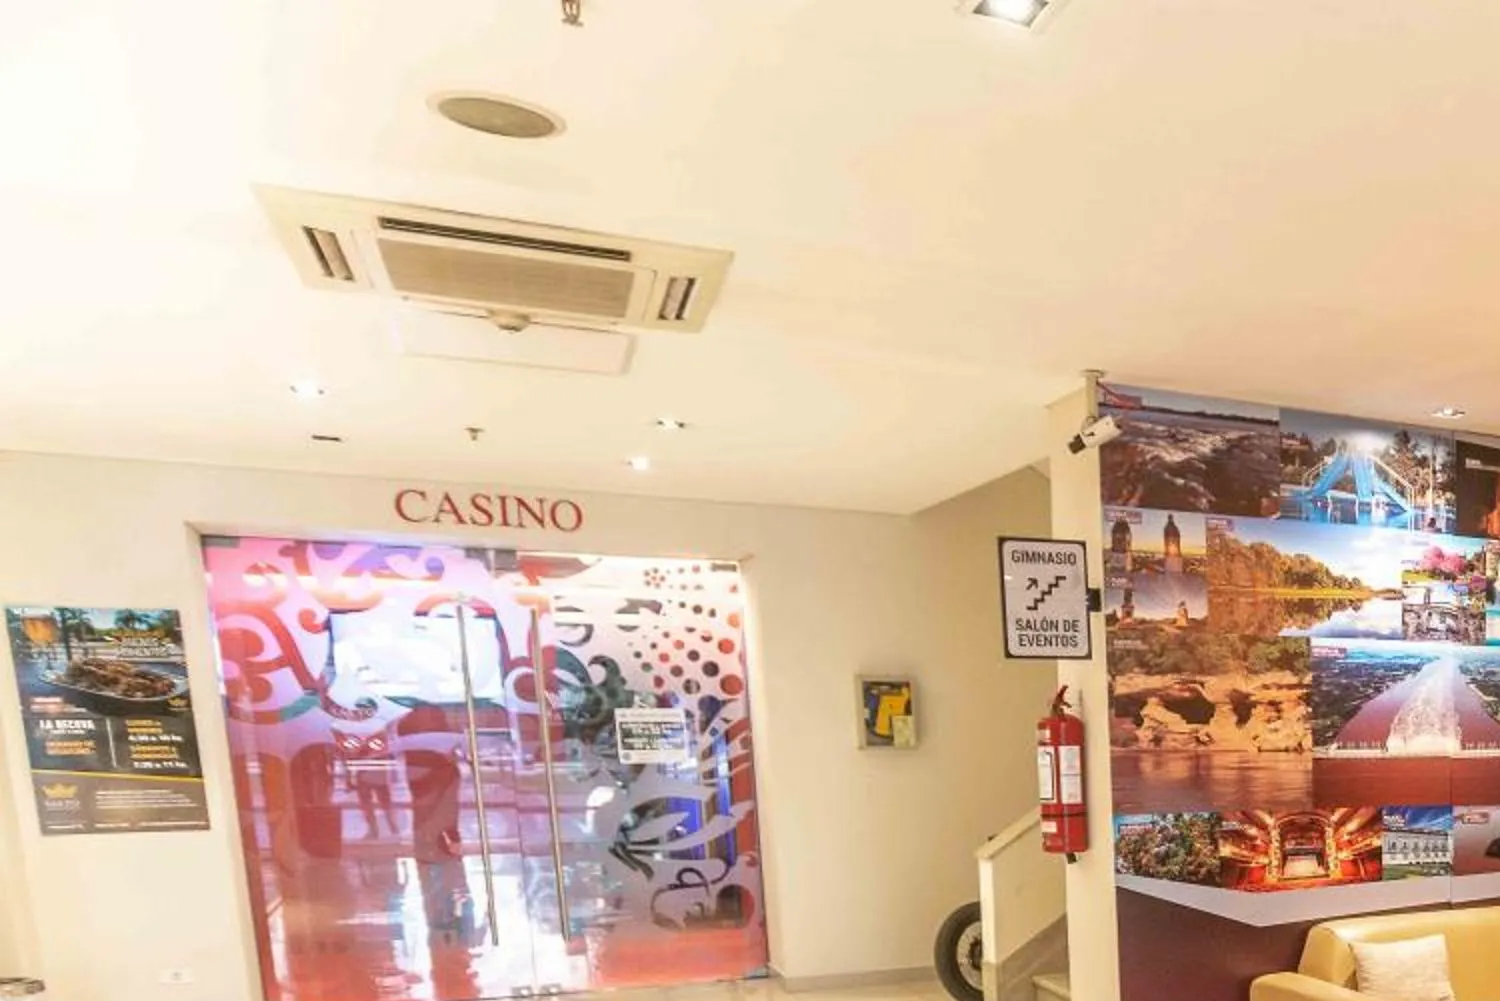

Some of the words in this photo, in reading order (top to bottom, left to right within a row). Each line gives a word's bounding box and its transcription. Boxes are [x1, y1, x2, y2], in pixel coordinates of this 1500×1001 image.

[394, 489, 583, 532] CASINO
[1011, 549, 1077, 566] GIMNASIO
[1015, 616, 1059, 632] SALÓN
[1063, 619, 1081, 633] DE
[1018, 634, 1079, 648] EVENTOS
